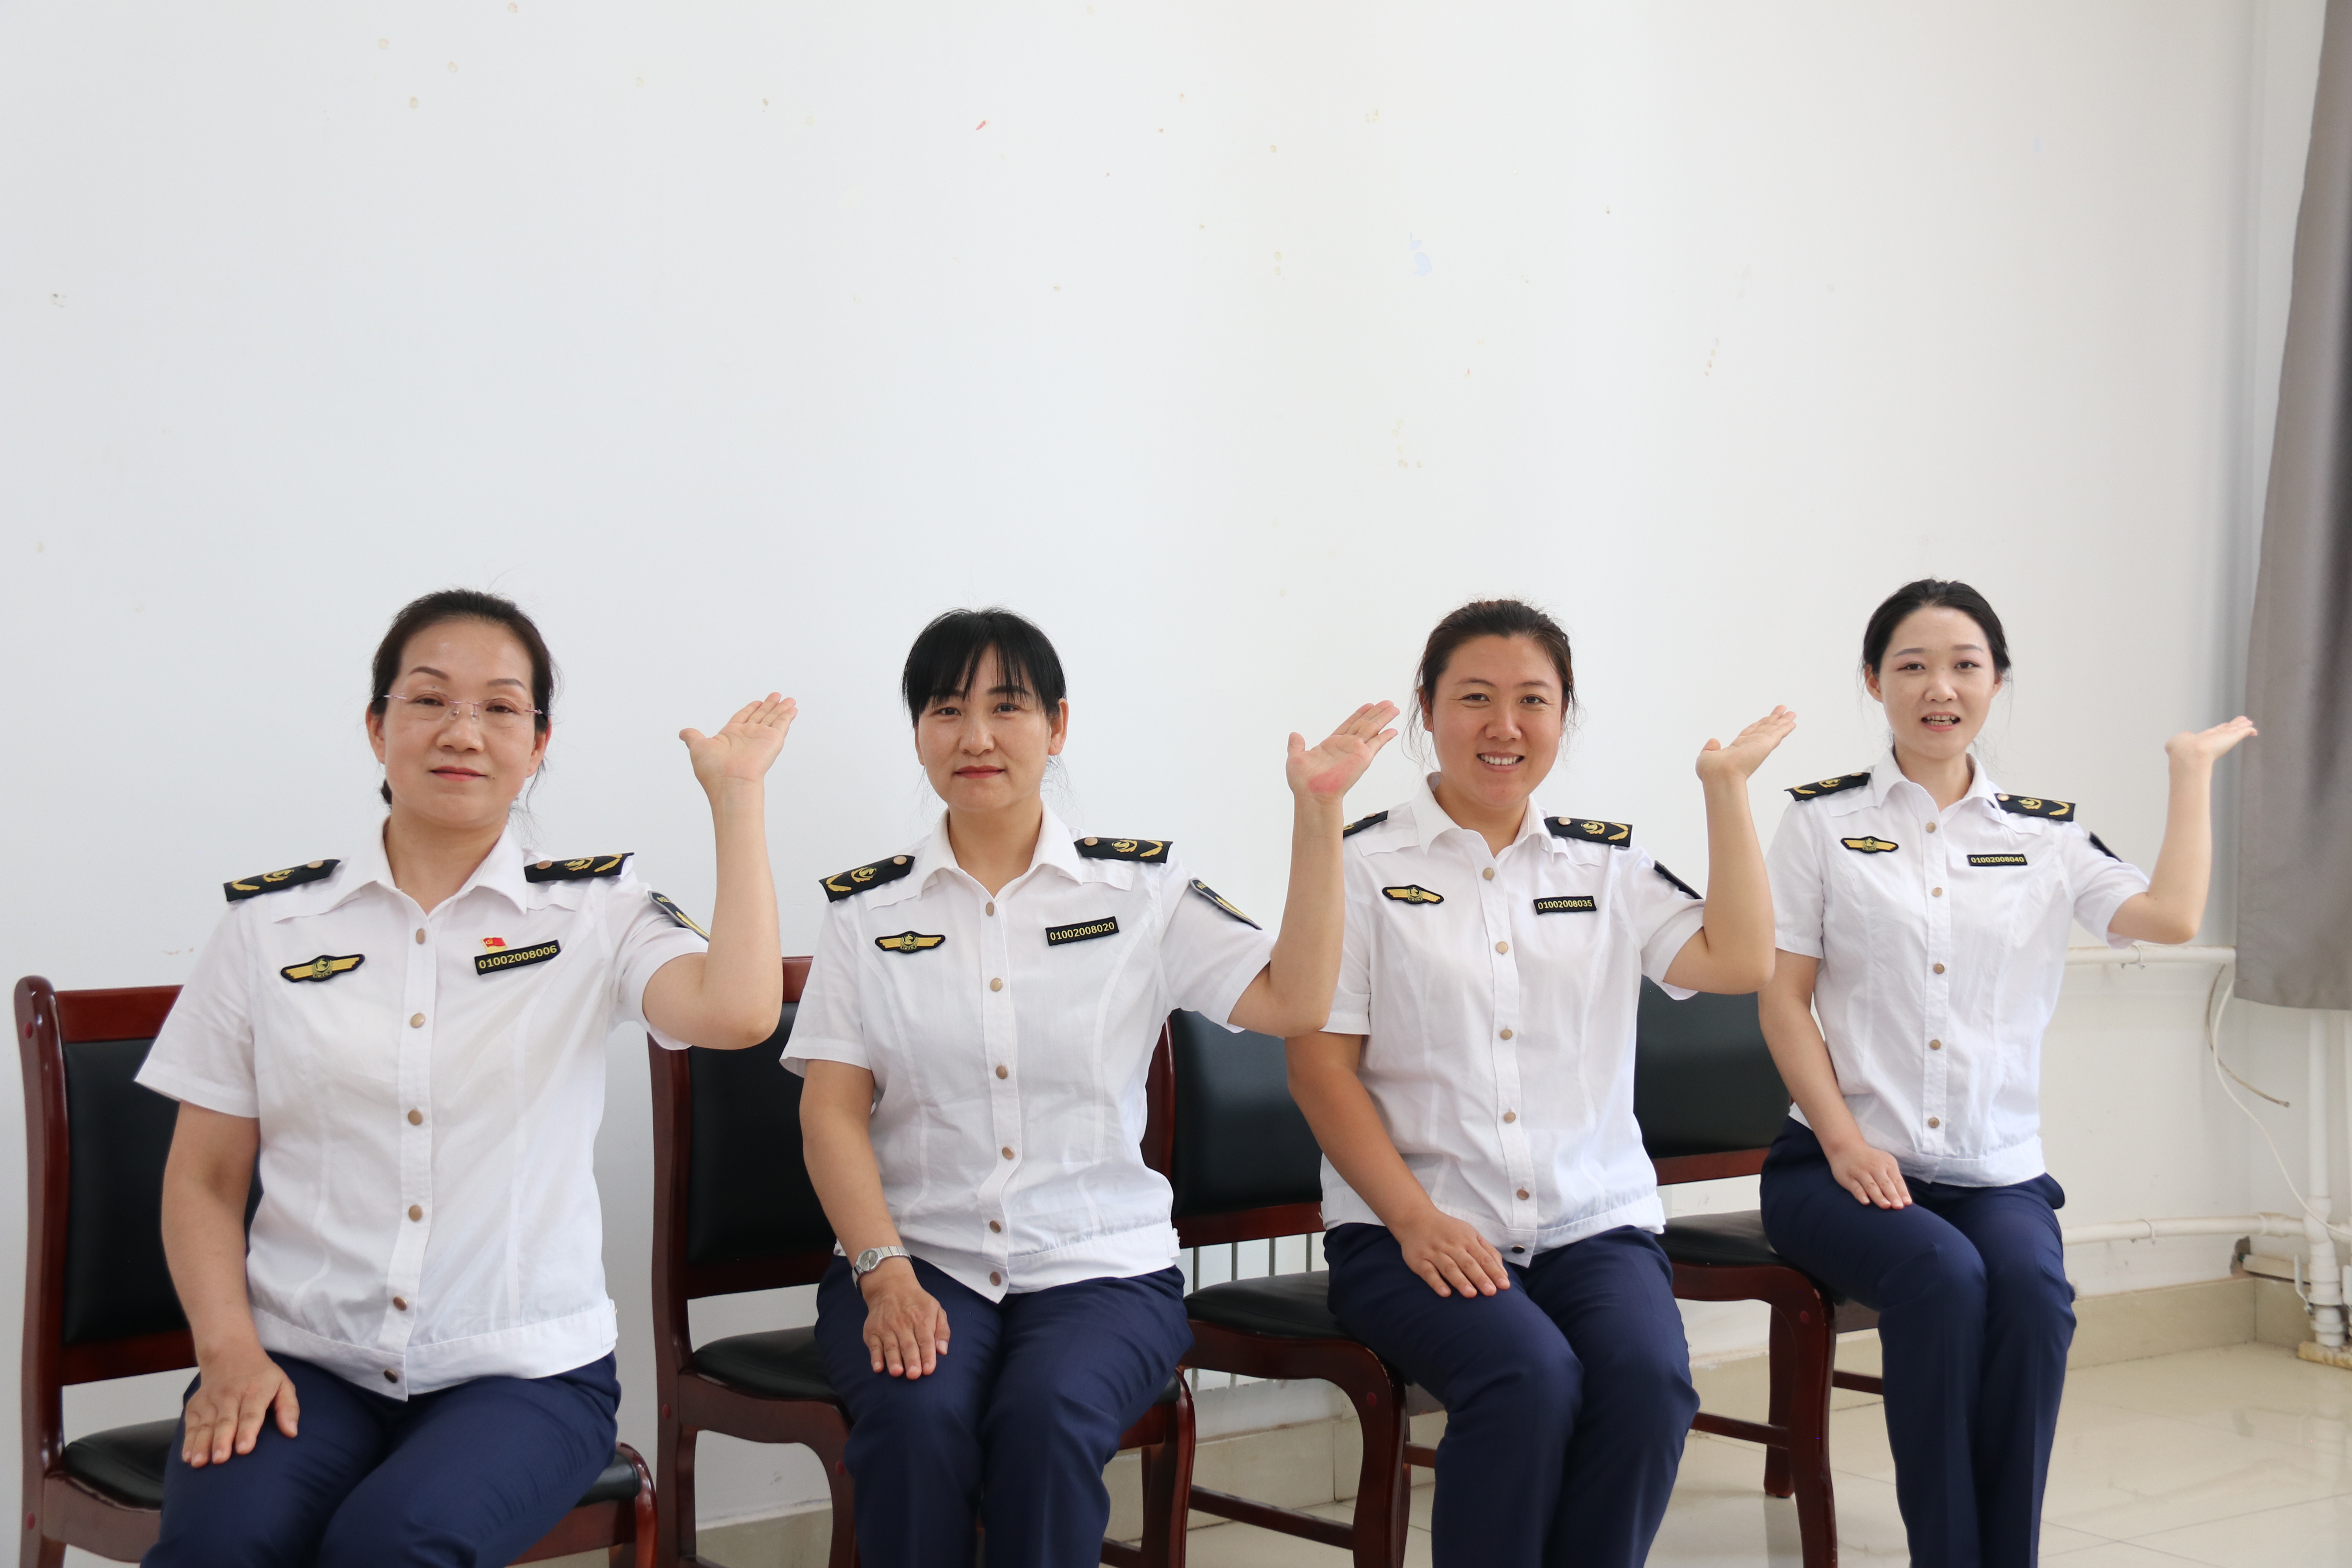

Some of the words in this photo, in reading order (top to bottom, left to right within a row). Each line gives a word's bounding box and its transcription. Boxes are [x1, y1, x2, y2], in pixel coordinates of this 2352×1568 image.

[1537, 899, 1593, 909] 01002008035
[1050, 922, 1115, 940] 01002008020
[479, 945, 557, 969] 01002008006
